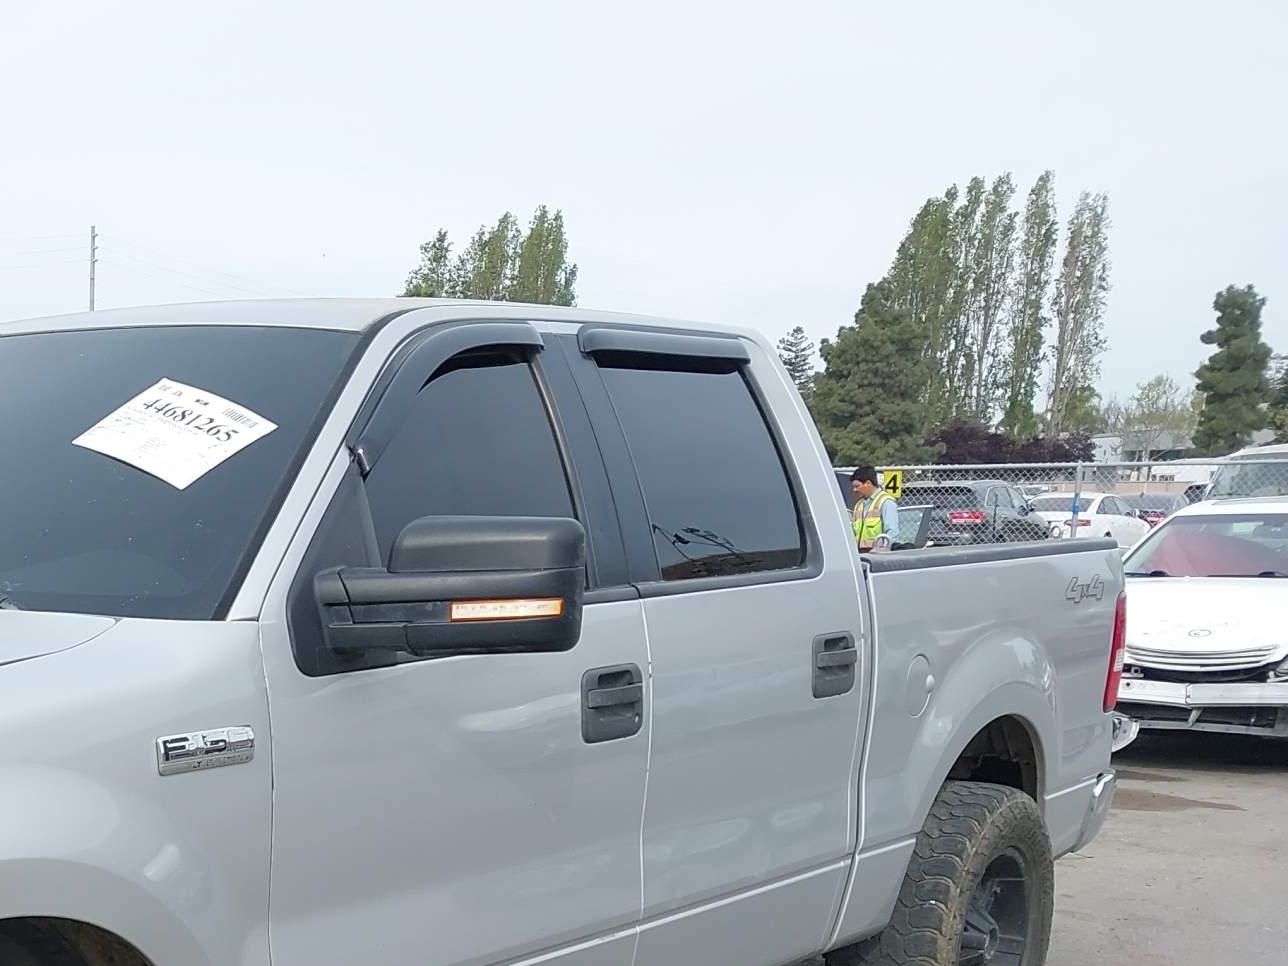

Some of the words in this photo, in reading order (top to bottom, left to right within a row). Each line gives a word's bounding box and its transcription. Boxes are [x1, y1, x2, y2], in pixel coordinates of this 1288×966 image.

[143, 399, 240, 441] 44681265
[885, 474, 899, 493] 4
[1064, 573, 1105, 604] 4x4
